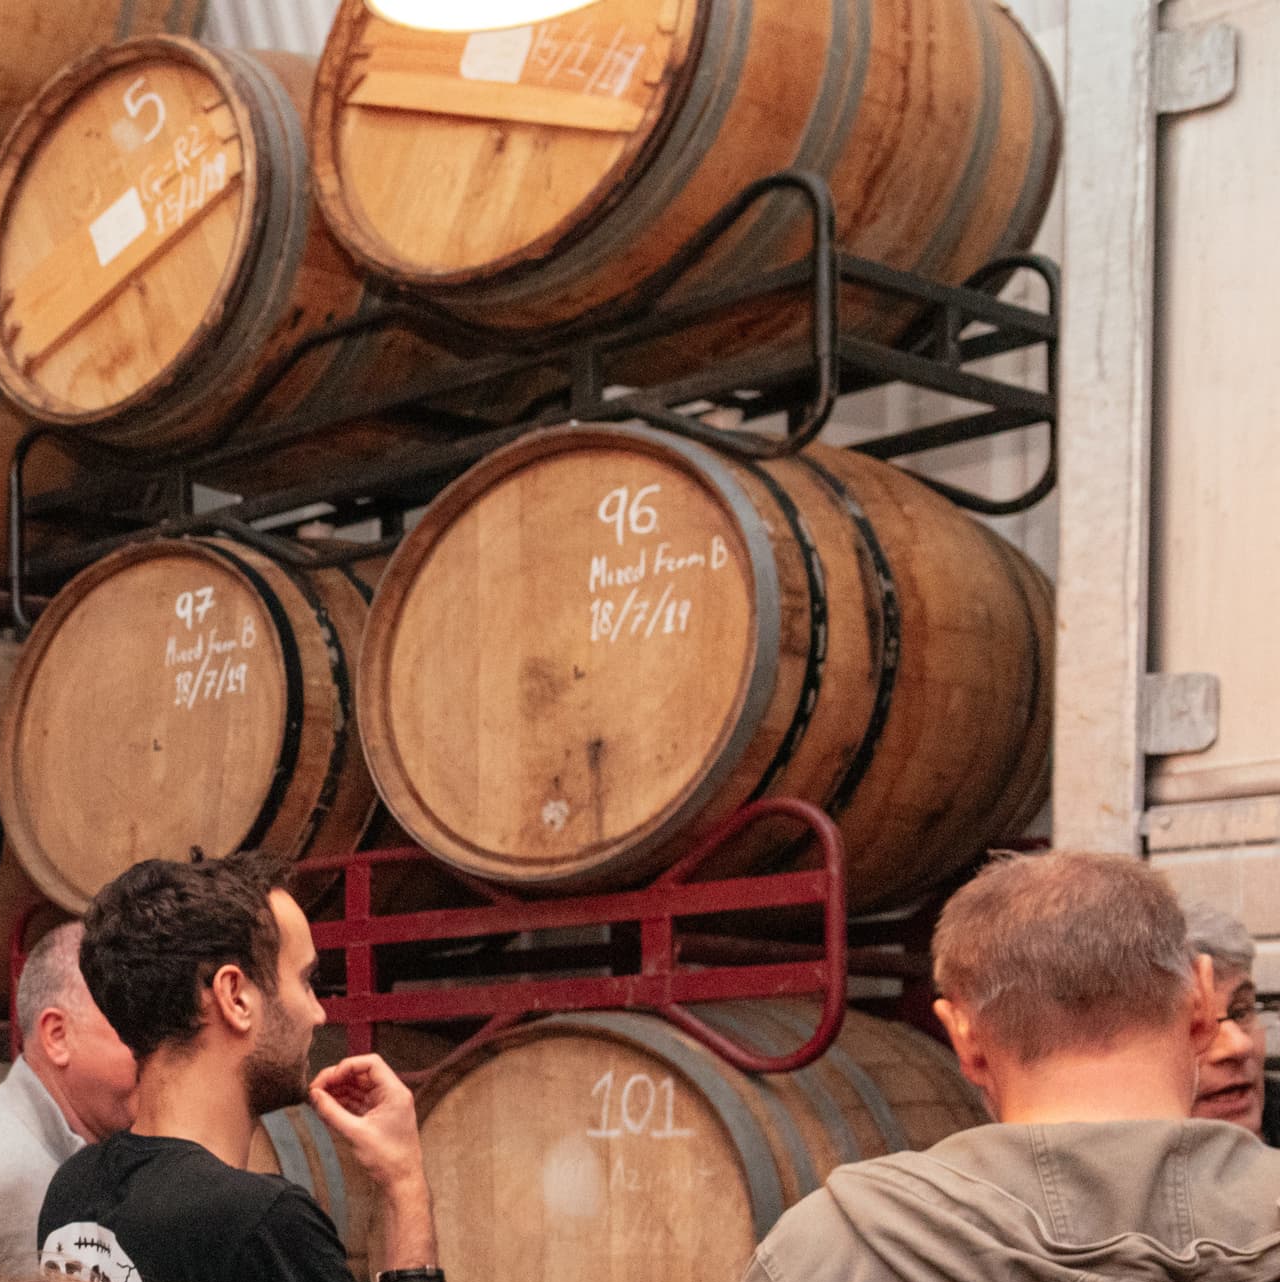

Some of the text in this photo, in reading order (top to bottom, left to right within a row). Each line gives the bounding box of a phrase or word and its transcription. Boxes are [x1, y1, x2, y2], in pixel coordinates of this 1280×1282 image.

[123, 78, 166, 144] 5
[597, 483, 661, 546] 96
[710, 534, 729, 570] B
[175, 585, 216, 631] 97
[240, 615, 257, 649] B
[590, 581, 692, 643] 18/7/19
[586, 1070, 697, 1138] 101
